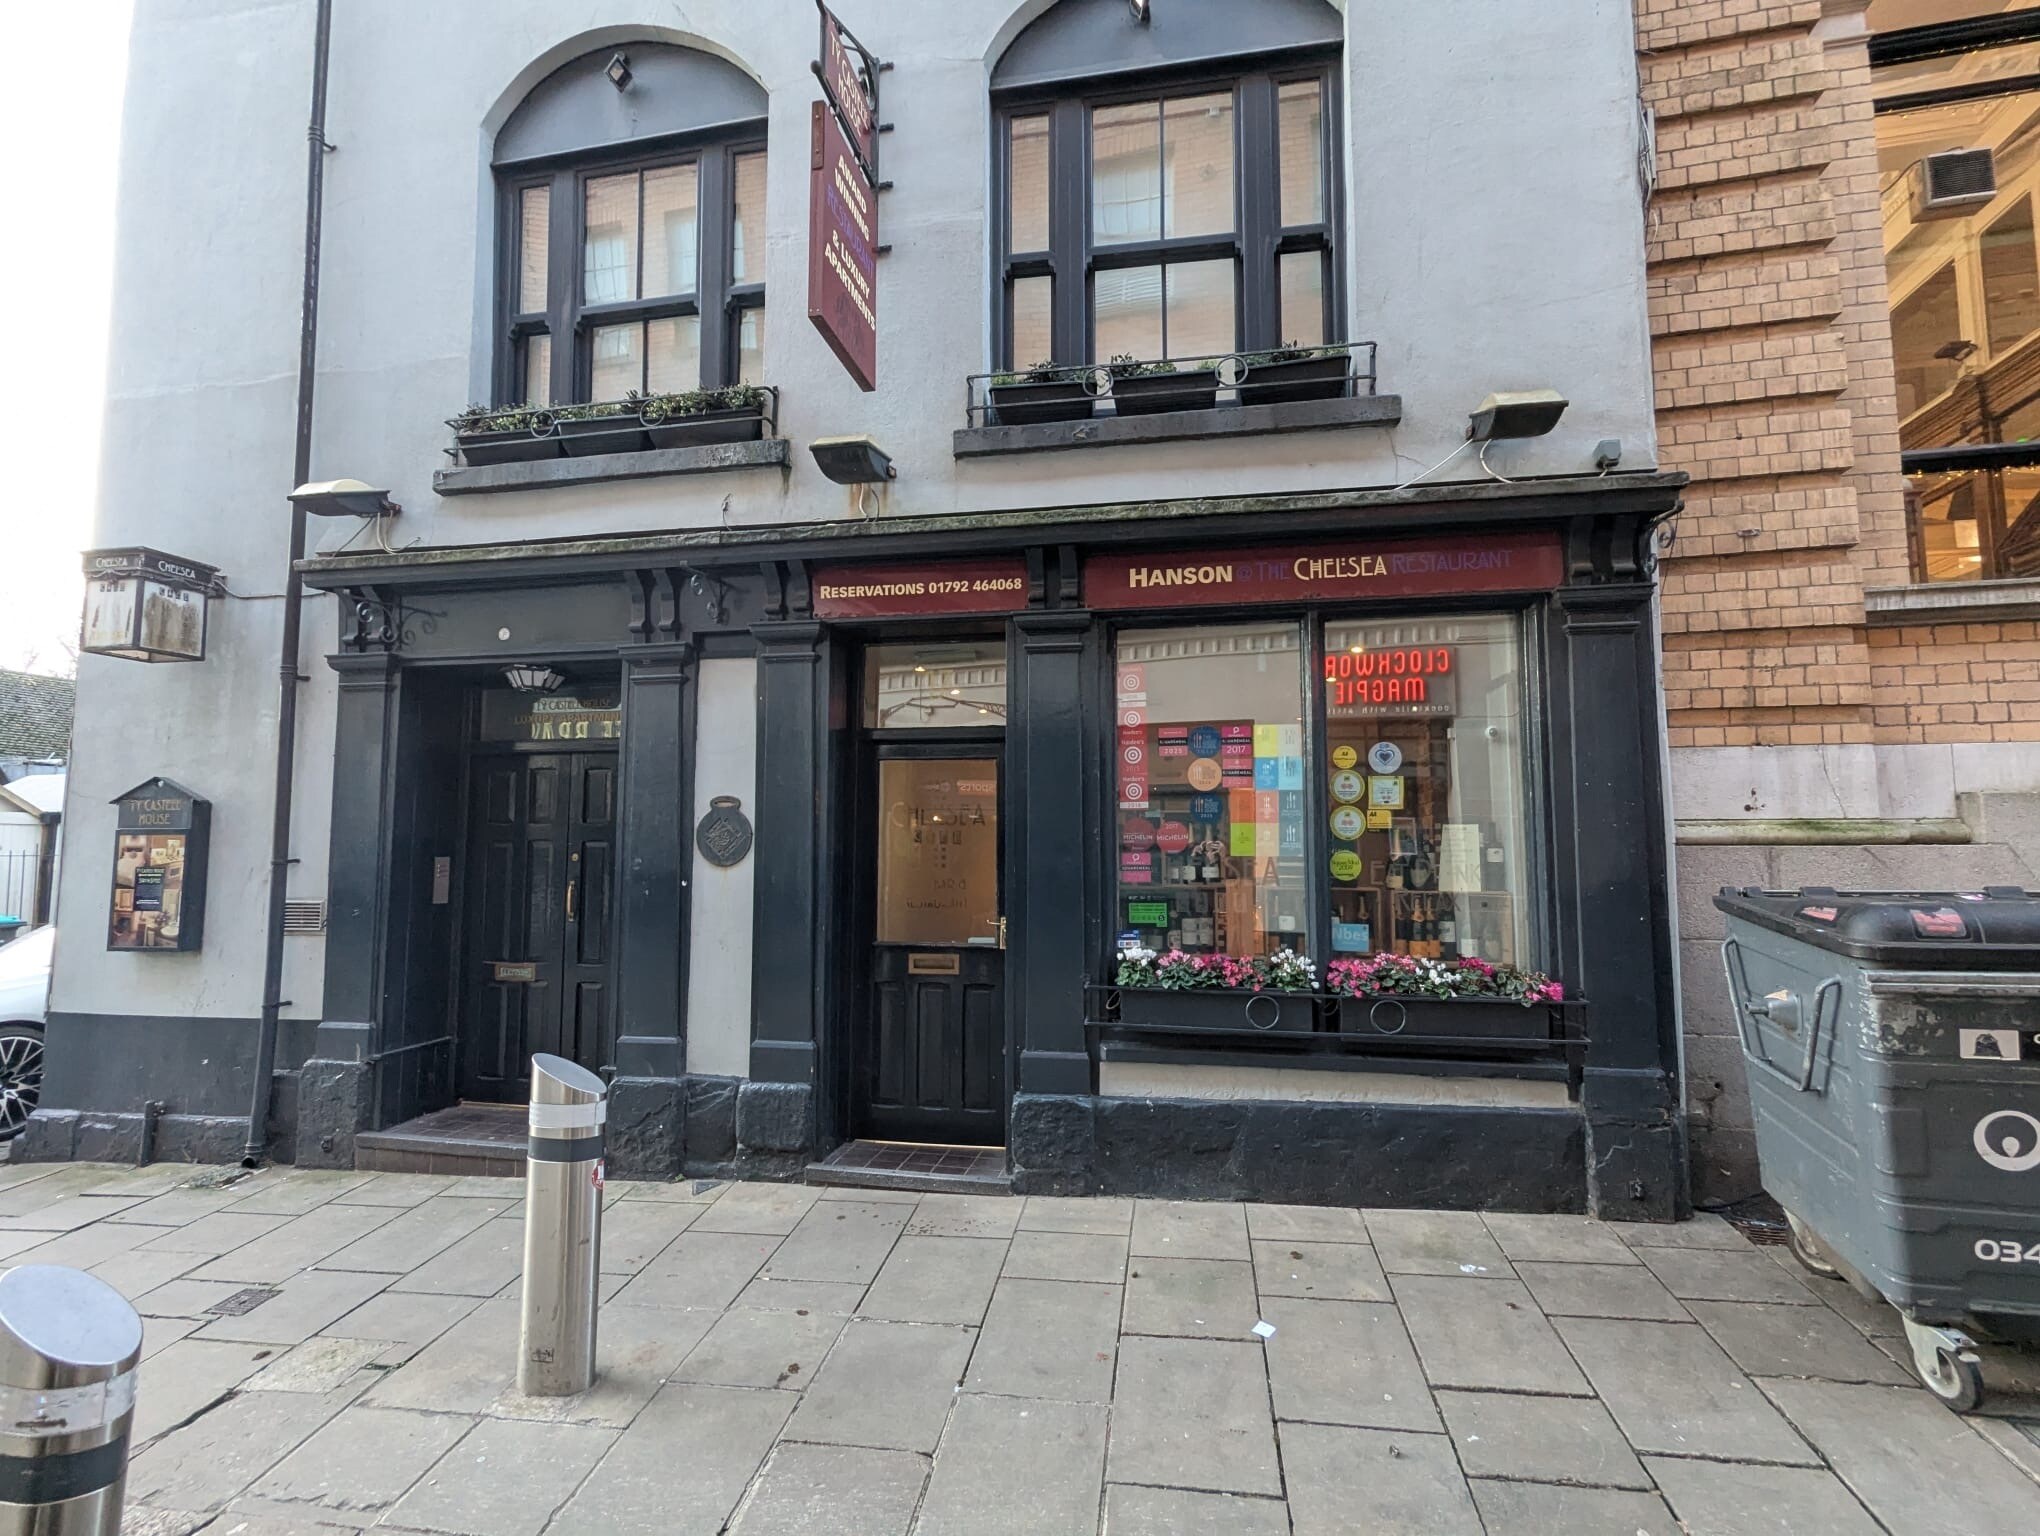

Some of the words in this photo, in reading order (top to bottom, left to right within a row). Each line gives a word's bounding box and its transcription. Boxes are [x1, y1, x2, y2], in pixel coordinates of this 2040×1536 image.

[830, 31, 841, 65] TY
[838, 154, 867, 214] AWARD
[834, 168, 870, 243] WINNING
[832, 229, 840, 251] &
[841, 242, 870, 300] LUXURY
[824, 242, 876, 332] APARTMENTS
[157, 560, 196, 579] CHELSEA
[1129, 565, 1233, 588] HANSON
[1294, 555, 1388, 581] CHELSEA
[1391, 550, 1513, 574] RESTAURANT
[820, 581, 925, 600] RESERVATIONS
[928, 580, 969, 594] 01792
[972, 578, 1022, 592] 464068
[1226, 745, 1246, 754] 2017
